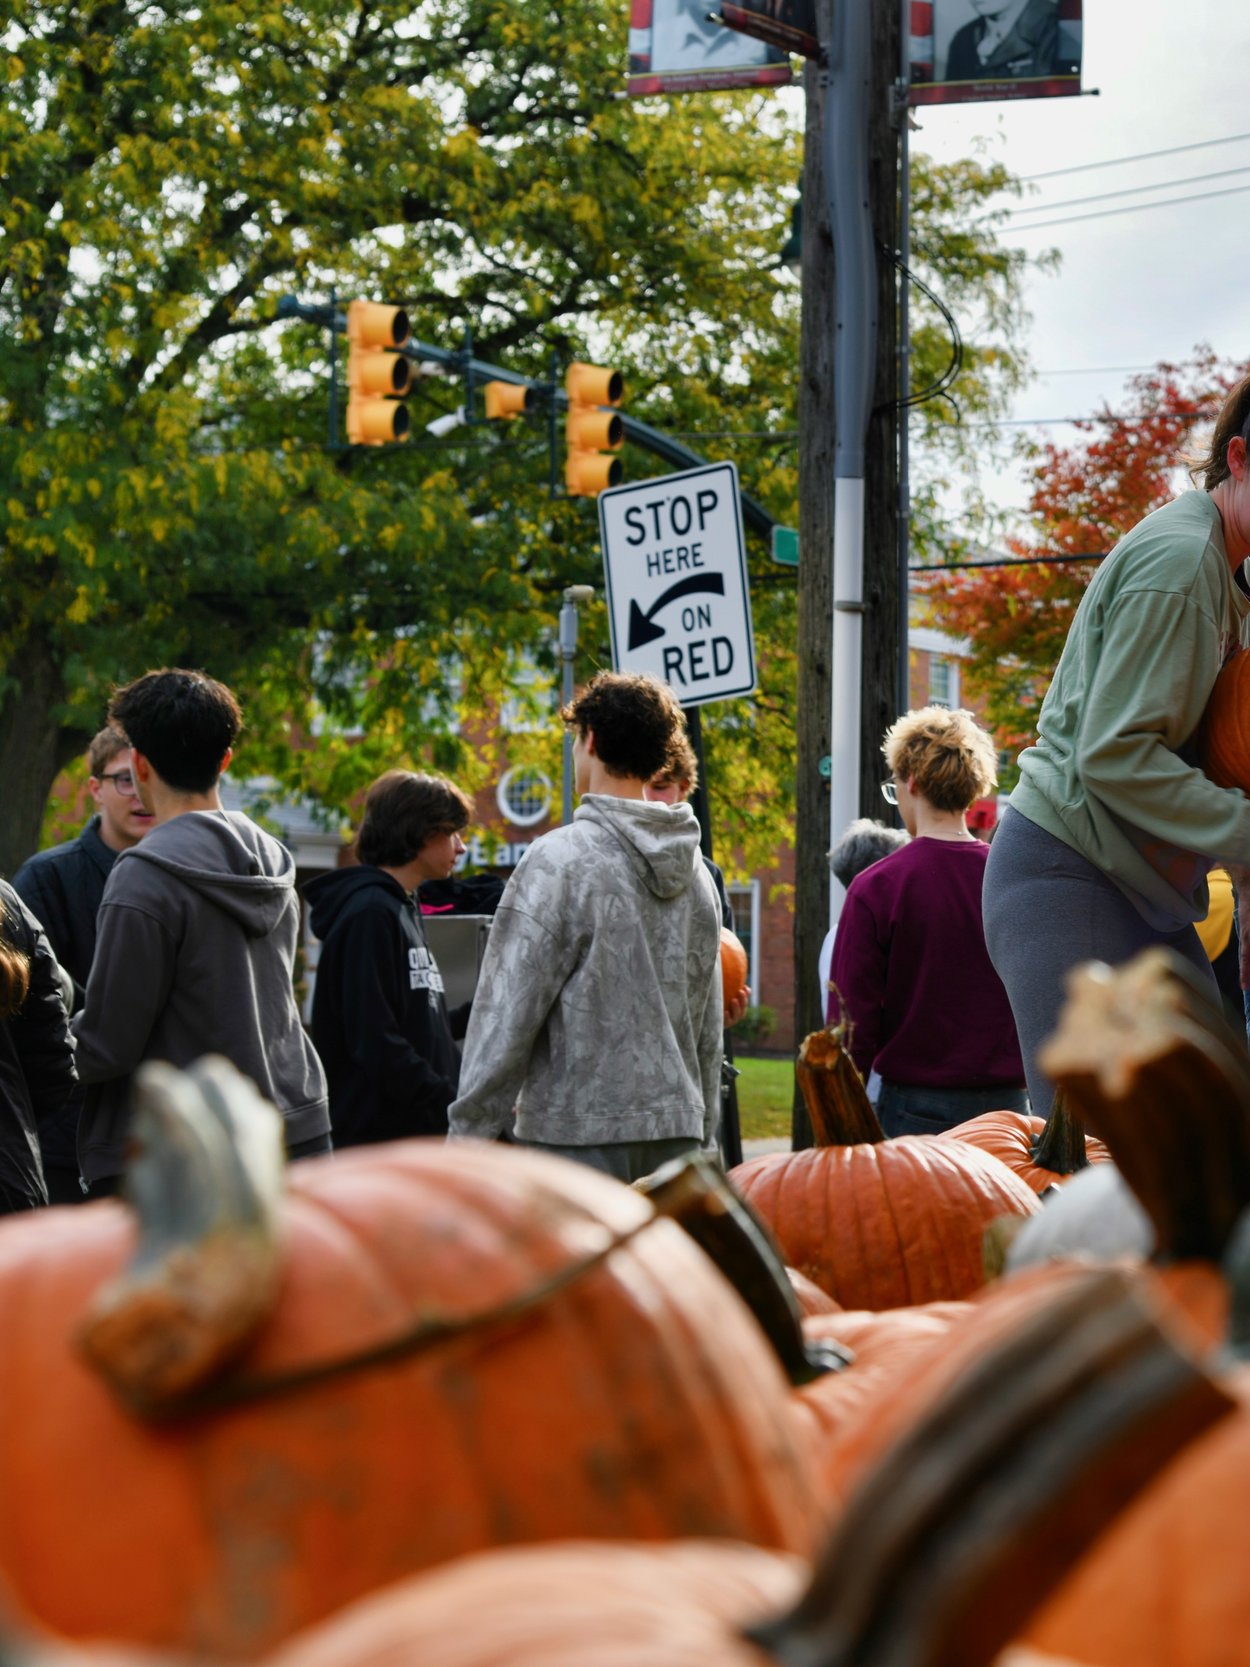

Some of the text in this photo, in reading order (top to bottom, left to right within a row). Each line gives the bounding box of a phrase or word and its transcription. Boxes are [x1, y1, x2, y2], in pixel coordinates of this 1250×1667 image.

[624, 489, 719, 546] STOP
[645, 542, 705, 578] HERE
[681, 603, 712, 632] ON
[663, 635, 734, 687] RED
